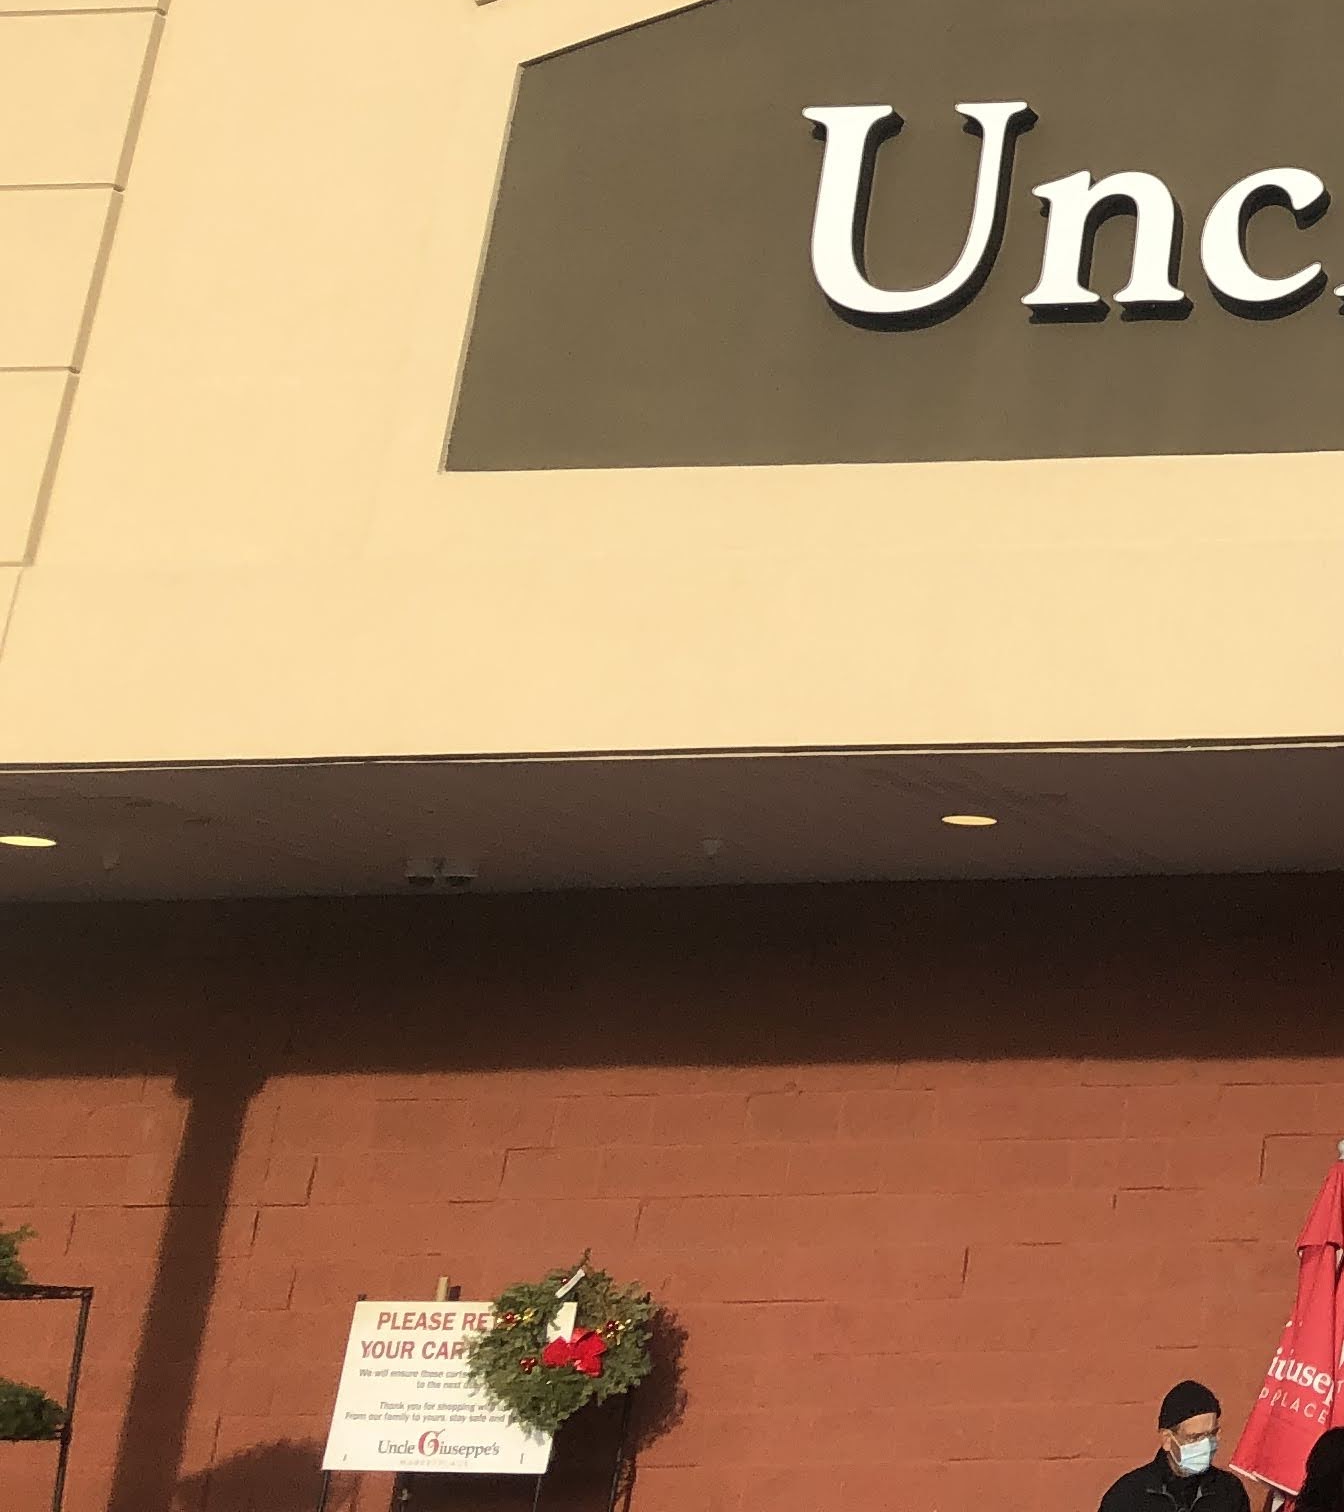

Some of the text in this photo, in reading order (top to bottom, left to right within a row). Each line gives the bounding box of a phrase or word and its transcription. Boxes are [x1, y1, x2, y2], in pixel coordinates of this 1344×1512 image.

[376, 1311, 491, 1332] PLEASE RE
[361, 1340, 465, 1360] YOUR CAR
[377, 1428, 500, 1458] Uncle Giuseppe's
